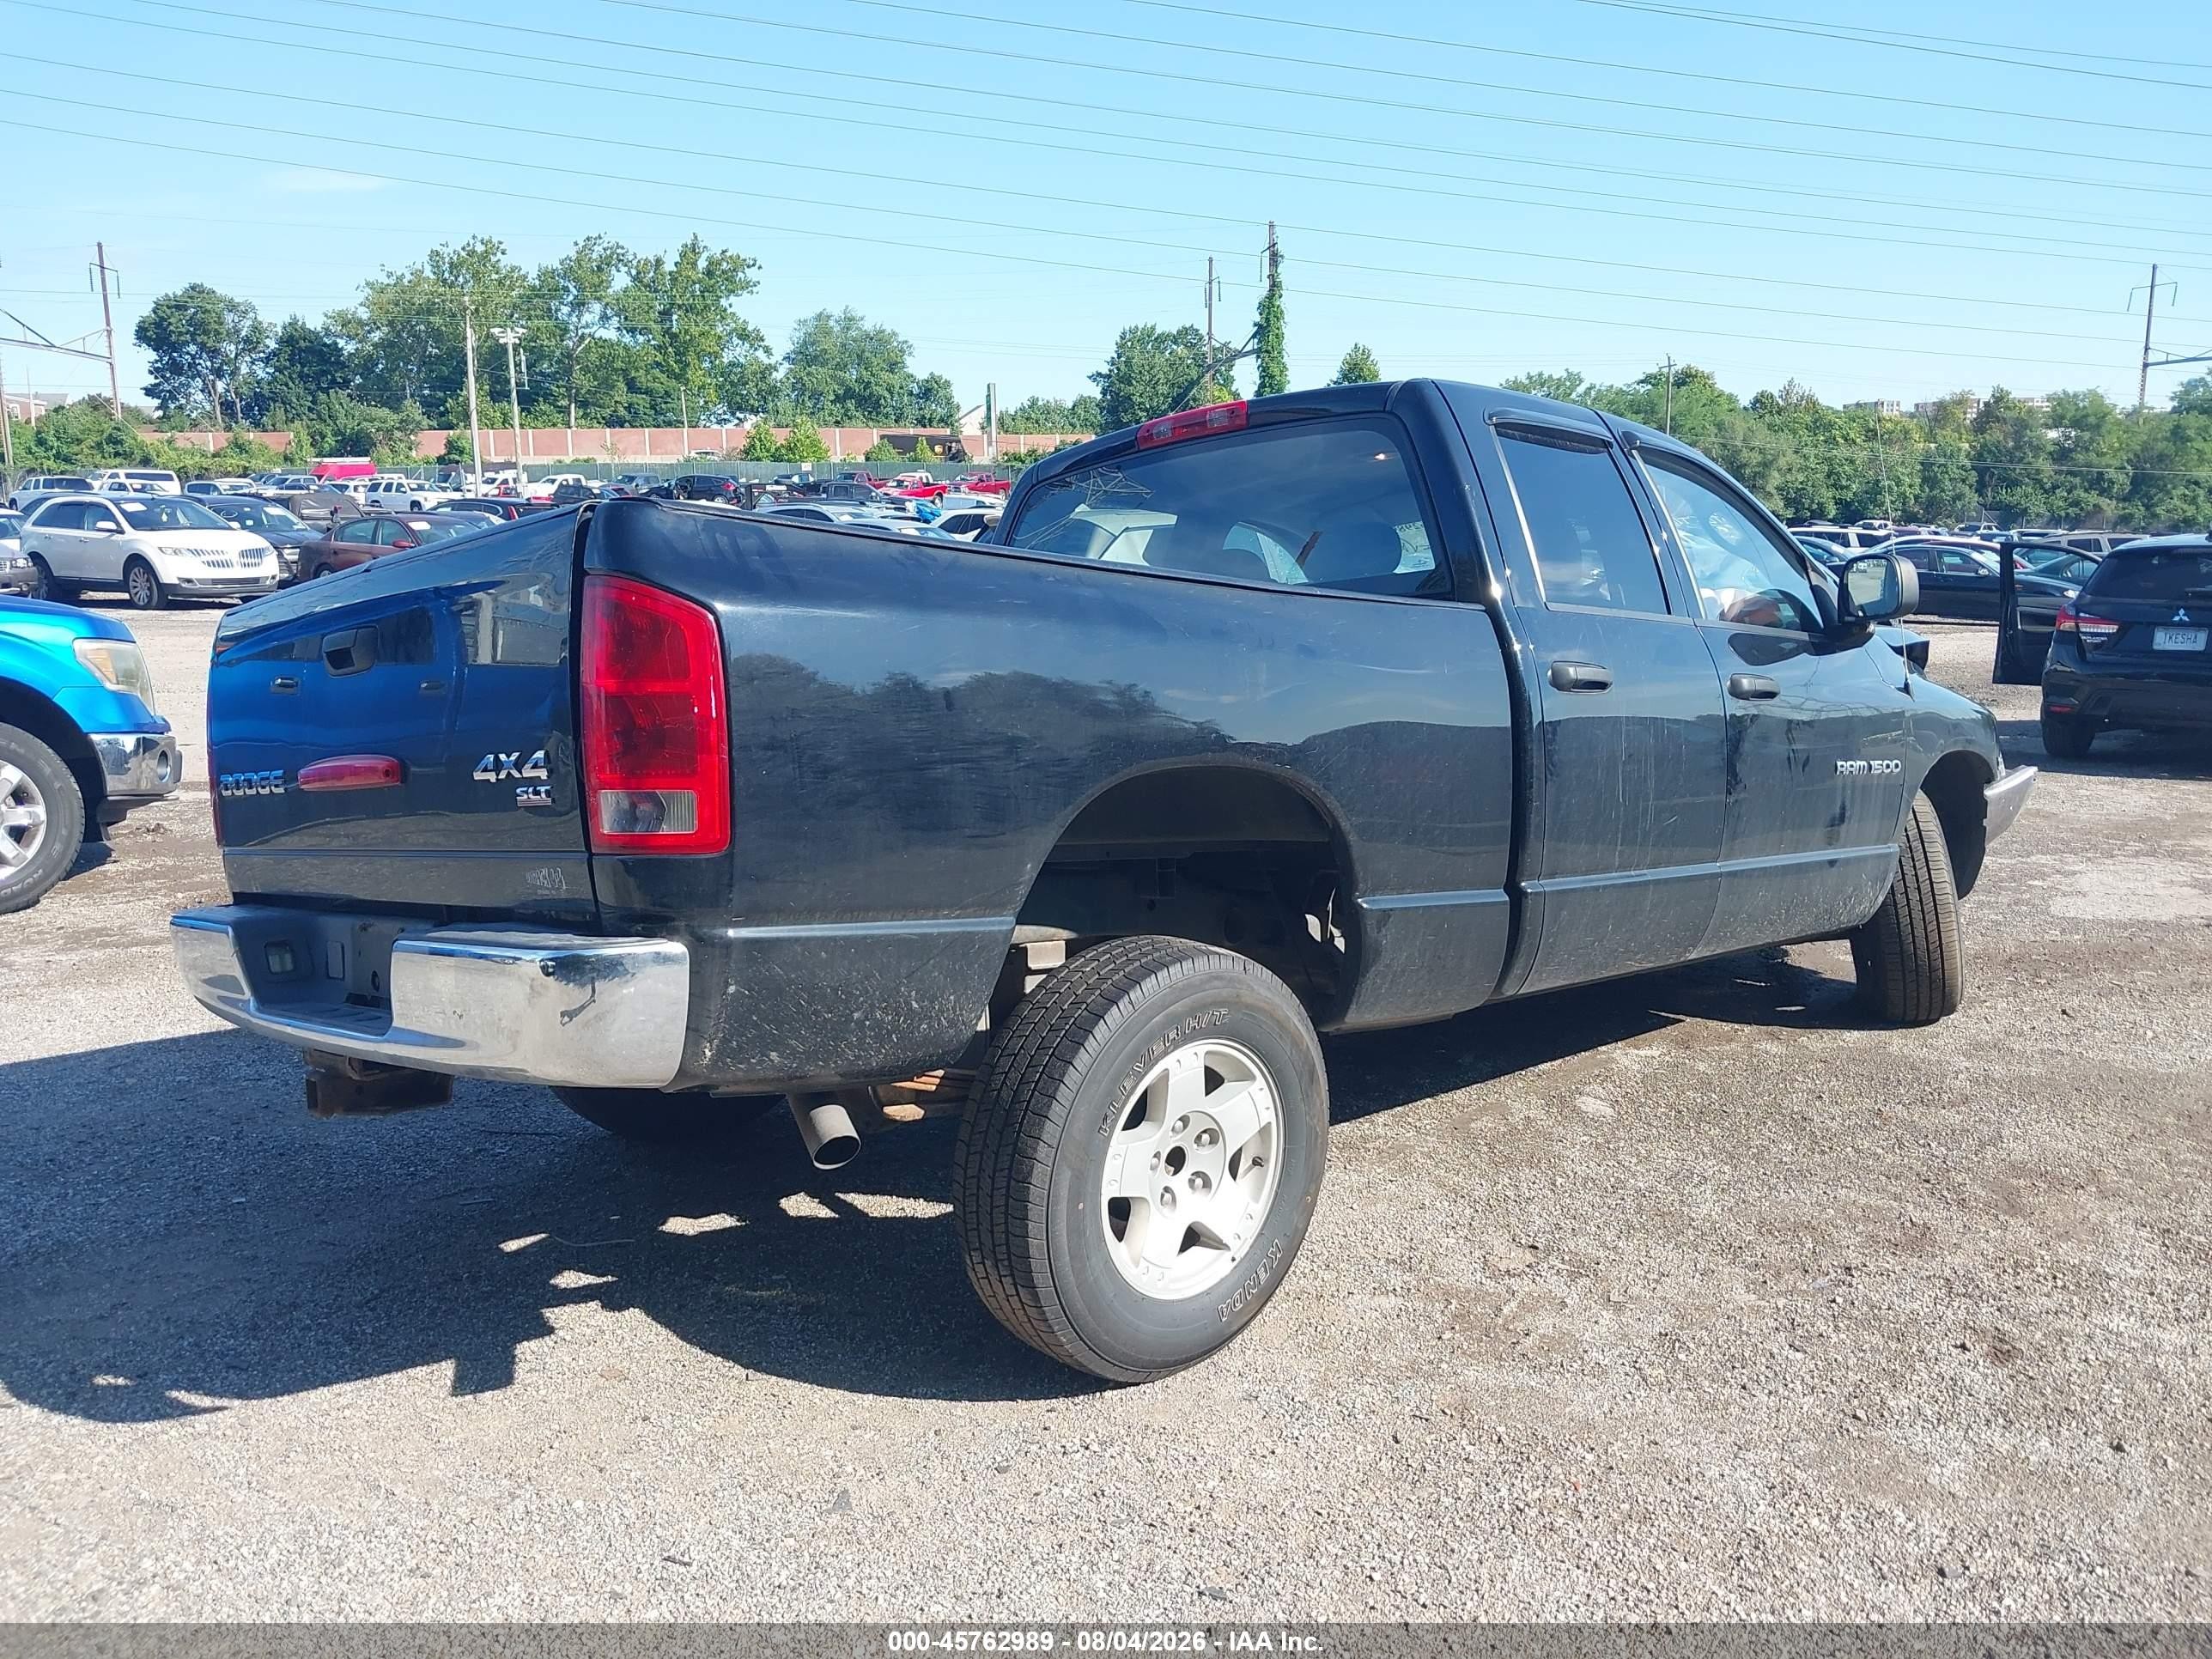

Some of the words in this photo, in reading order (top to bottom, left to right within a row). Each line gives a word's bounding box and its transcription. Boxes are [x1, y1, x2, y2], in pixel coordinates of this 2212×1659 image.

[472, 750, 549, 783] 4X4
[1836, 760, 1868, 775] RAM
[1869, 759, 1902, 775] 1500
[220, 769, 286, 797] DODGE
[515, 786, 551, 799] SLT
[1098, 1024, 1182, 1137] KLEVER
[1185, 1008, 1229, 1034] H/T
[1218, 1238, 1283, 1322] KENDA
